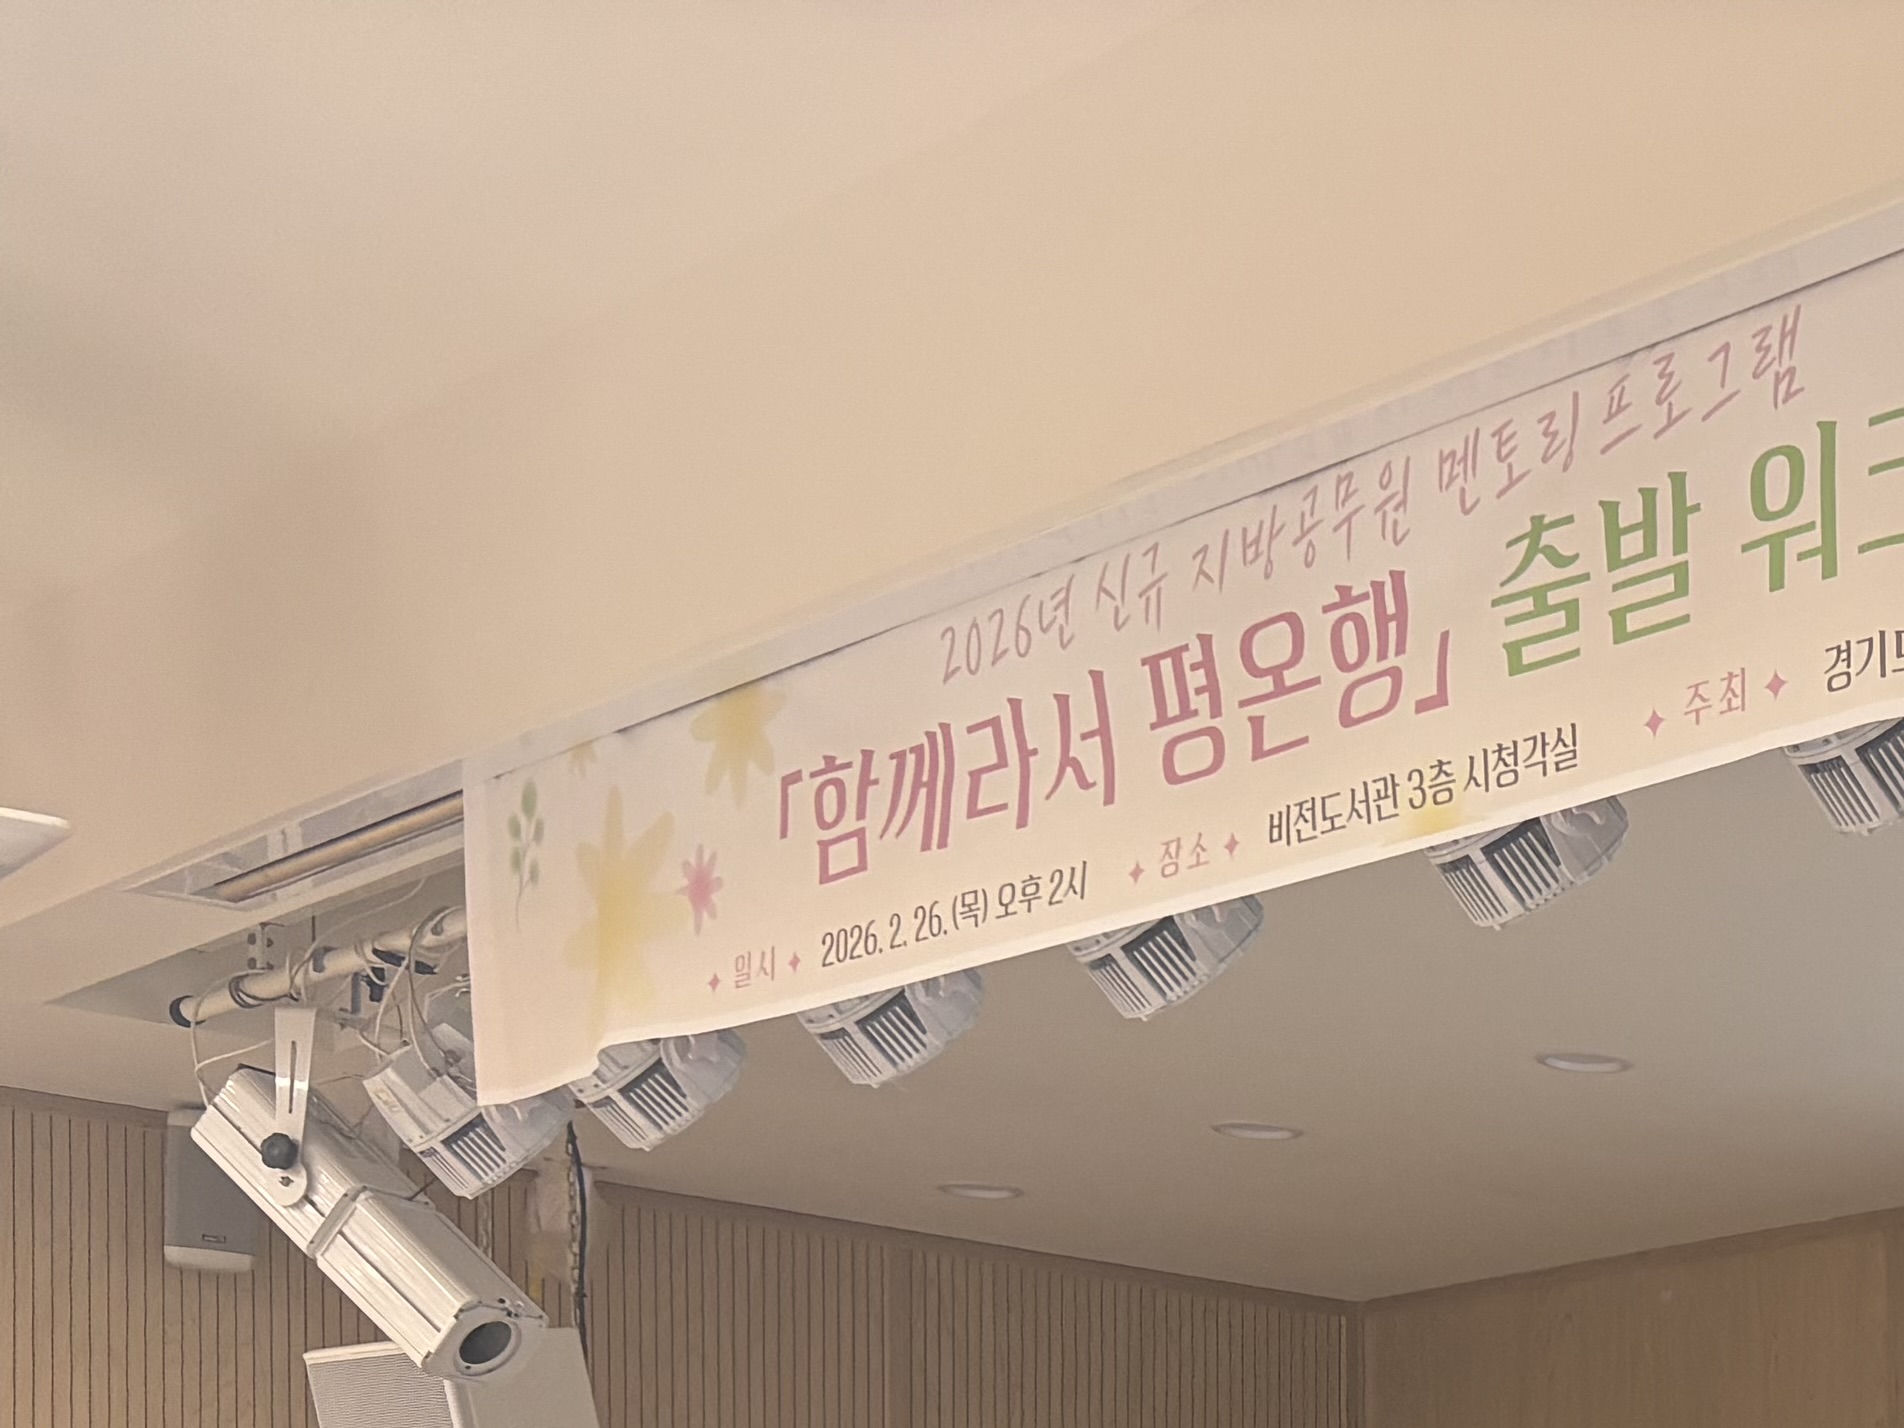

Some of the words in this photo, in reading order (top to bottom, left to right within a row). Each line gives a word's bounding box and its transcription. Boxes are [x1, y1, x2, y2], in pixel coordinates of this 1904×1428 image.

[779, 667, 1116, 885] 「함께라서
[1140, 568, 1450, 786] 평온행」
[1490, 471, 1705, 677] 출발
[940, 573, 1075, 685] 2026년
[1096, 541, 1168, 632] 신규
[1192, 456, 1411, 592] 지방공무원
[1438, 390, 1580, 516] 멘토링
[1600, 303, 1805, 456] 프로그램
[734, 946, 776, 988] 일시
[821, 919, 883, 968] 2026.
[995, 874, 1043, 920] 오후
[1047, 860, 1088, 907] 2시
[1160, 832, 1210, 879] 장소
[1268, 773, 1401, 847] 비전도서관
[1407, 758, 1456, 810] 3층
[1463, 722, 1579, 794] 시청각실
[1683, 666, 1749, 727] 주최
